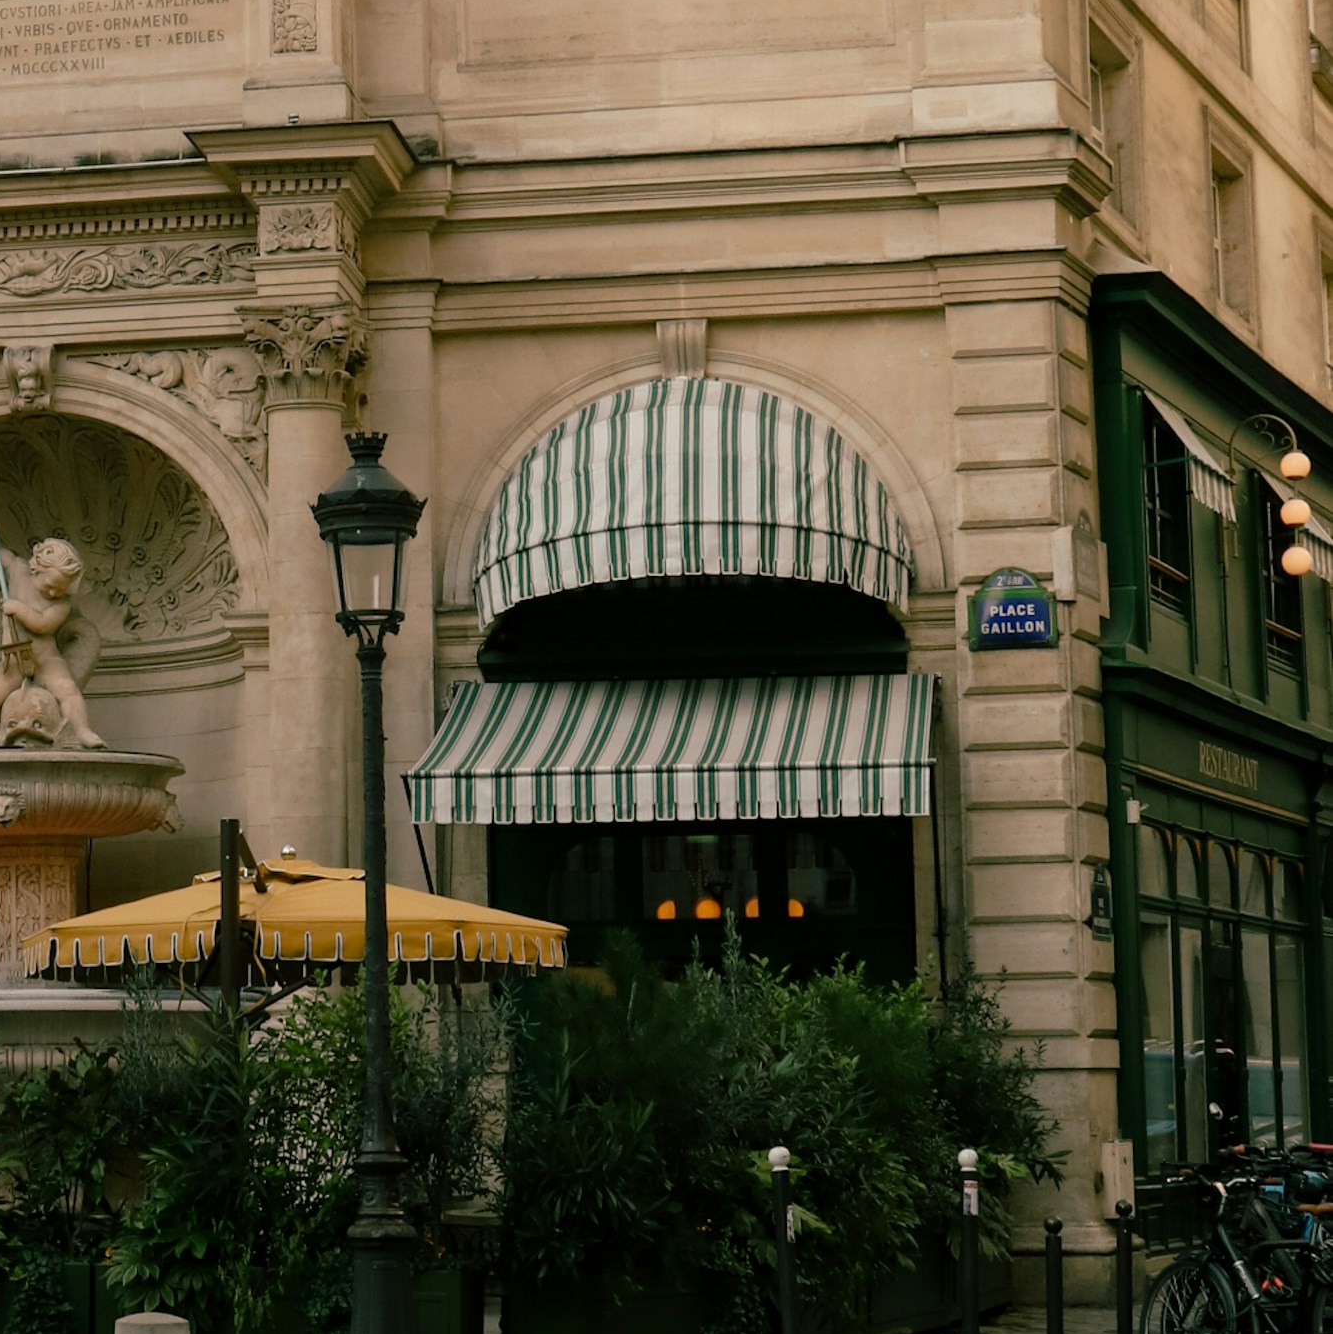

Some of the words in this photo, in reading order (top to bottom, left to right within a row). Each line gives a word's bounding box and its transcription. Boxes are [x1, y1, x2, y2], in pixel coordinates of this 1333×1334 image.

[69, 1, 103, 15] AREA
[14, 22, 56, 38] VRBIS
[65, 19, 94, 36] QVE
[102, 12, 190, 31] ORNAMENTO
[34, 36, 122, 56] PRAEFECTVS
[134, 34, 152, 49] ET
[166, 29, 226, 46] AEDILES
[10, 56, 106, 76] MDCCCXXVIII
[990, 604, 1035, 617] PLACE
[981, 621, 1045, 634] GAILLON
[1198, 740, 1259, 791] RESTAURANT
